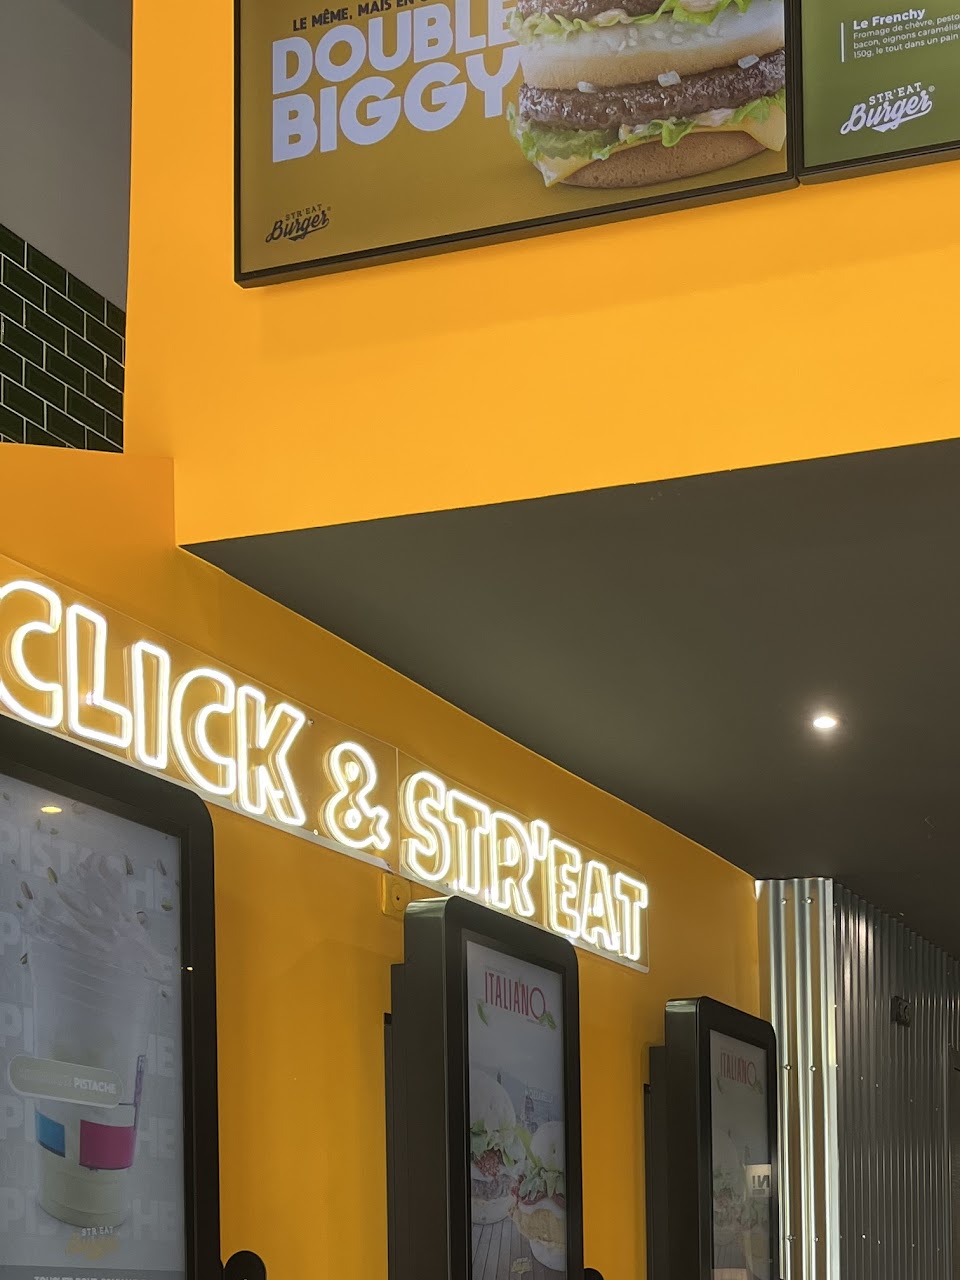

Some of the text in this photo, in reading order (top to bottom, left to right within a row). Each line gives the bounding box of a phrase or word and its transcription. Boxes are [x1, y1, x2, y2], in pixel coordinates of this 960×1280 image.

[293, 18, 307, 31] LE
[358, 0, 391, 16] MAIS
[853, 8, 926, 30] Le Frenchy
[853, 28, 890, 40] Fromage
[892, 24, 903, 32] de
[936, 14, 960, 25] pesto,
[272, 0, 520, 95] DOUBLE
[853, 39, 880, 49] bacon,
[882, 32, 916, 45] oignons
[854, 48, 874, 59] 150g,
[876, 46, 883, 54] le
[885, 43, 902, 52] tout
[904, 39, 925, 49] dans
[927, 37, 938, 45] un
[940, 32, 958, 43] pain
[272, 45, 521, 162] BIGGY
[869, 82, 921, 105] STR'EAT
[840, 90, 932, 135] Burger
[265, 210, 330, 243] Burger
[285, 203, 322, 221] STR'EAT
[0, 579, 650, 961] CLICK & STR'EAT
[485, 971, 546, 1020] ITALIANO
[720, 1051, 757, 1088] ITALIANO
[73, 1077, 117, 1094] PISTACHE
